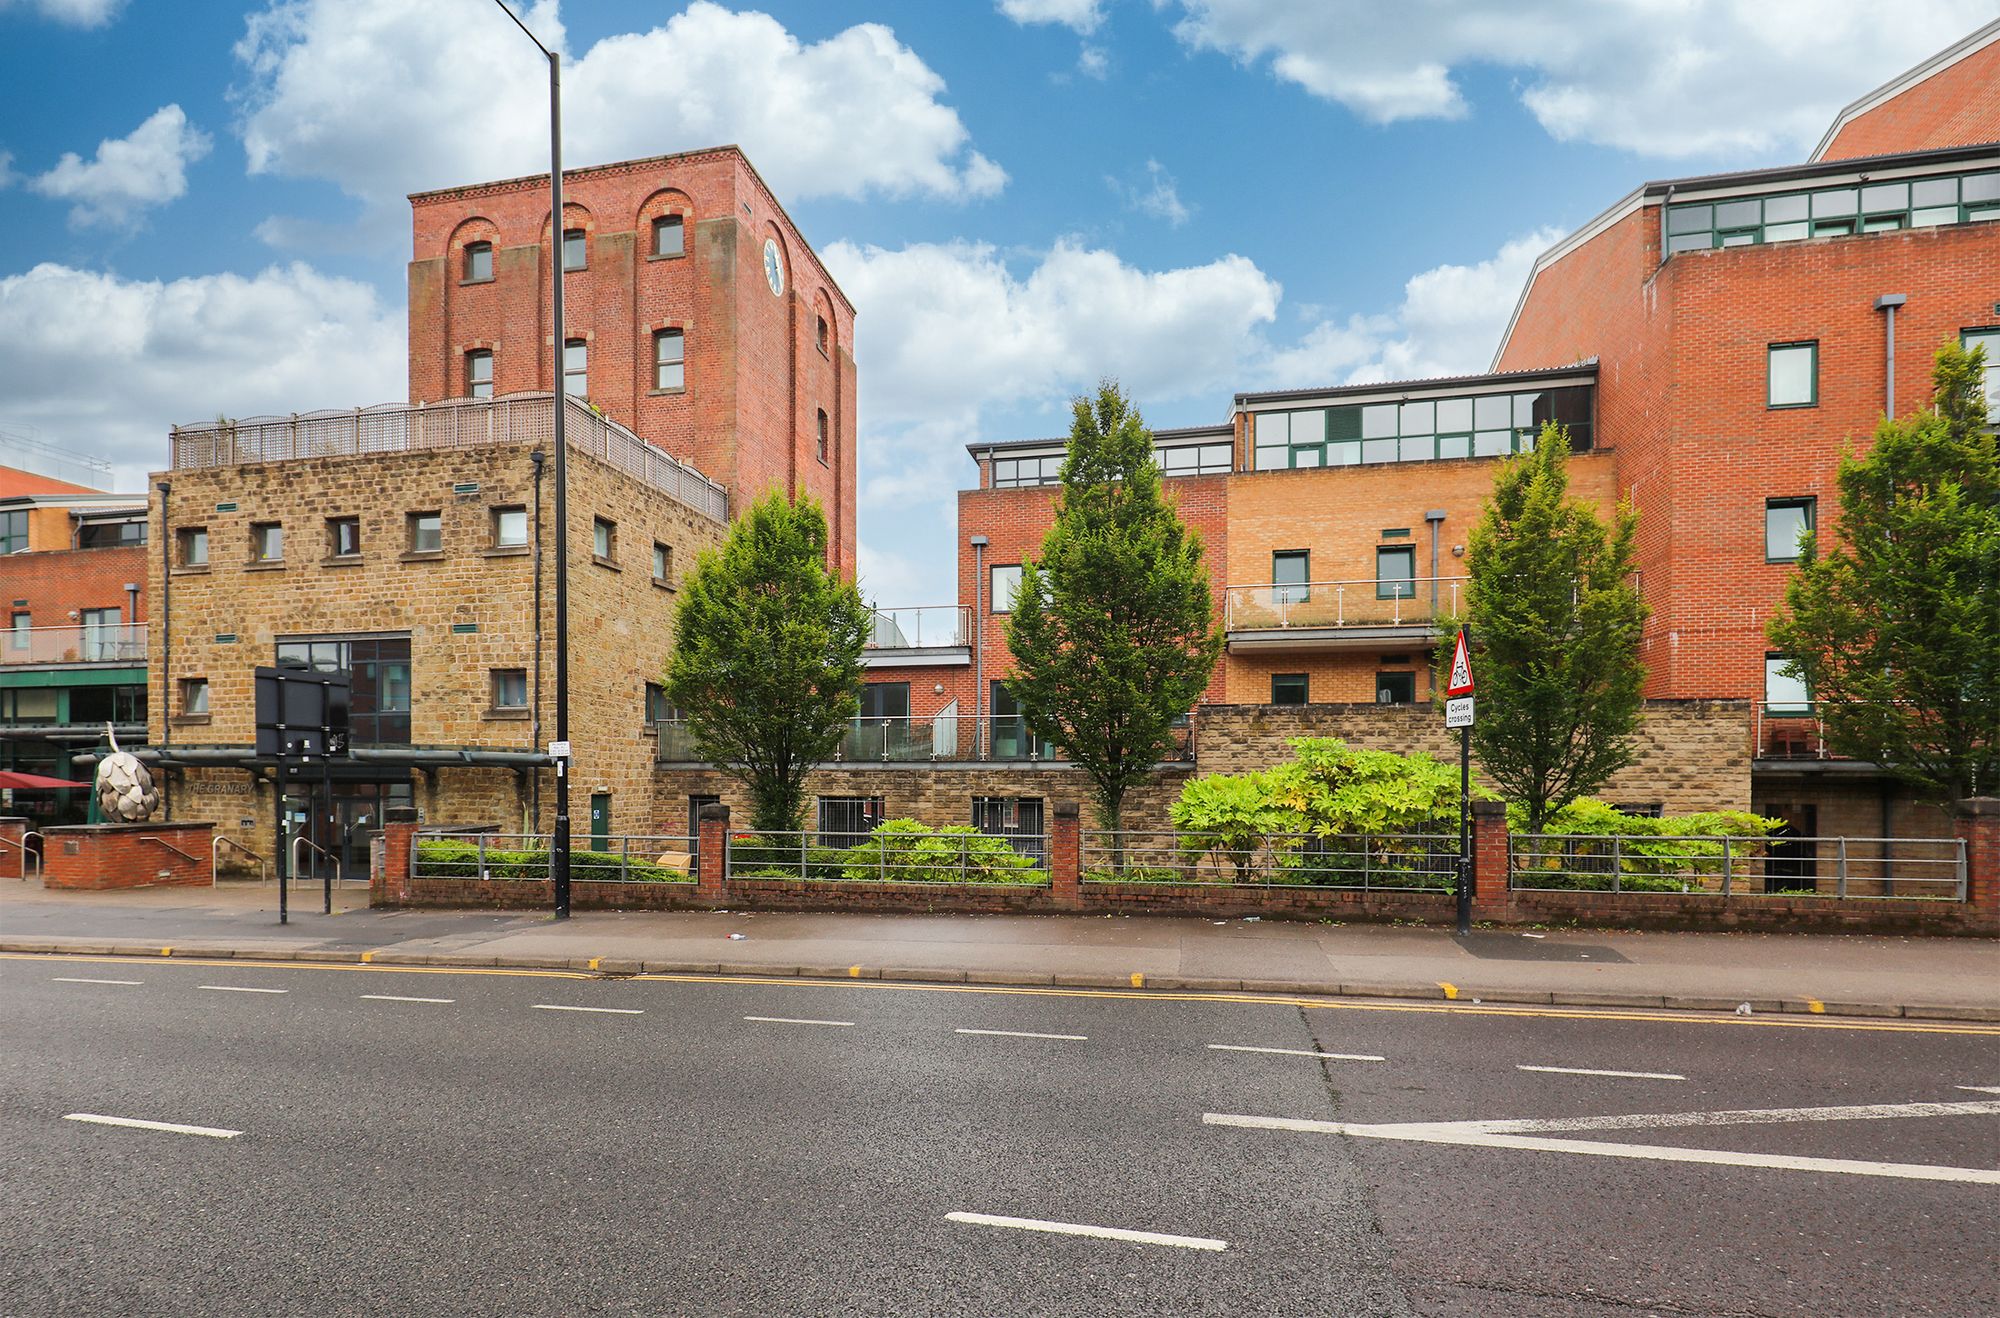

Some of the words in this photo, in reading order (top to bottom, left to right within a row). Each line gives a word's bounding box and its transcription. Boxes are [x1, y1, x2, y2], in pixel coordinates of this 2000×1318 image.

[1451, 702, 1469, 713] Cycles
[1448, 714, 1471, 723] crossing
[189, 783, 206, 794] THE
[207, 783, 254, 794] GRANARY
